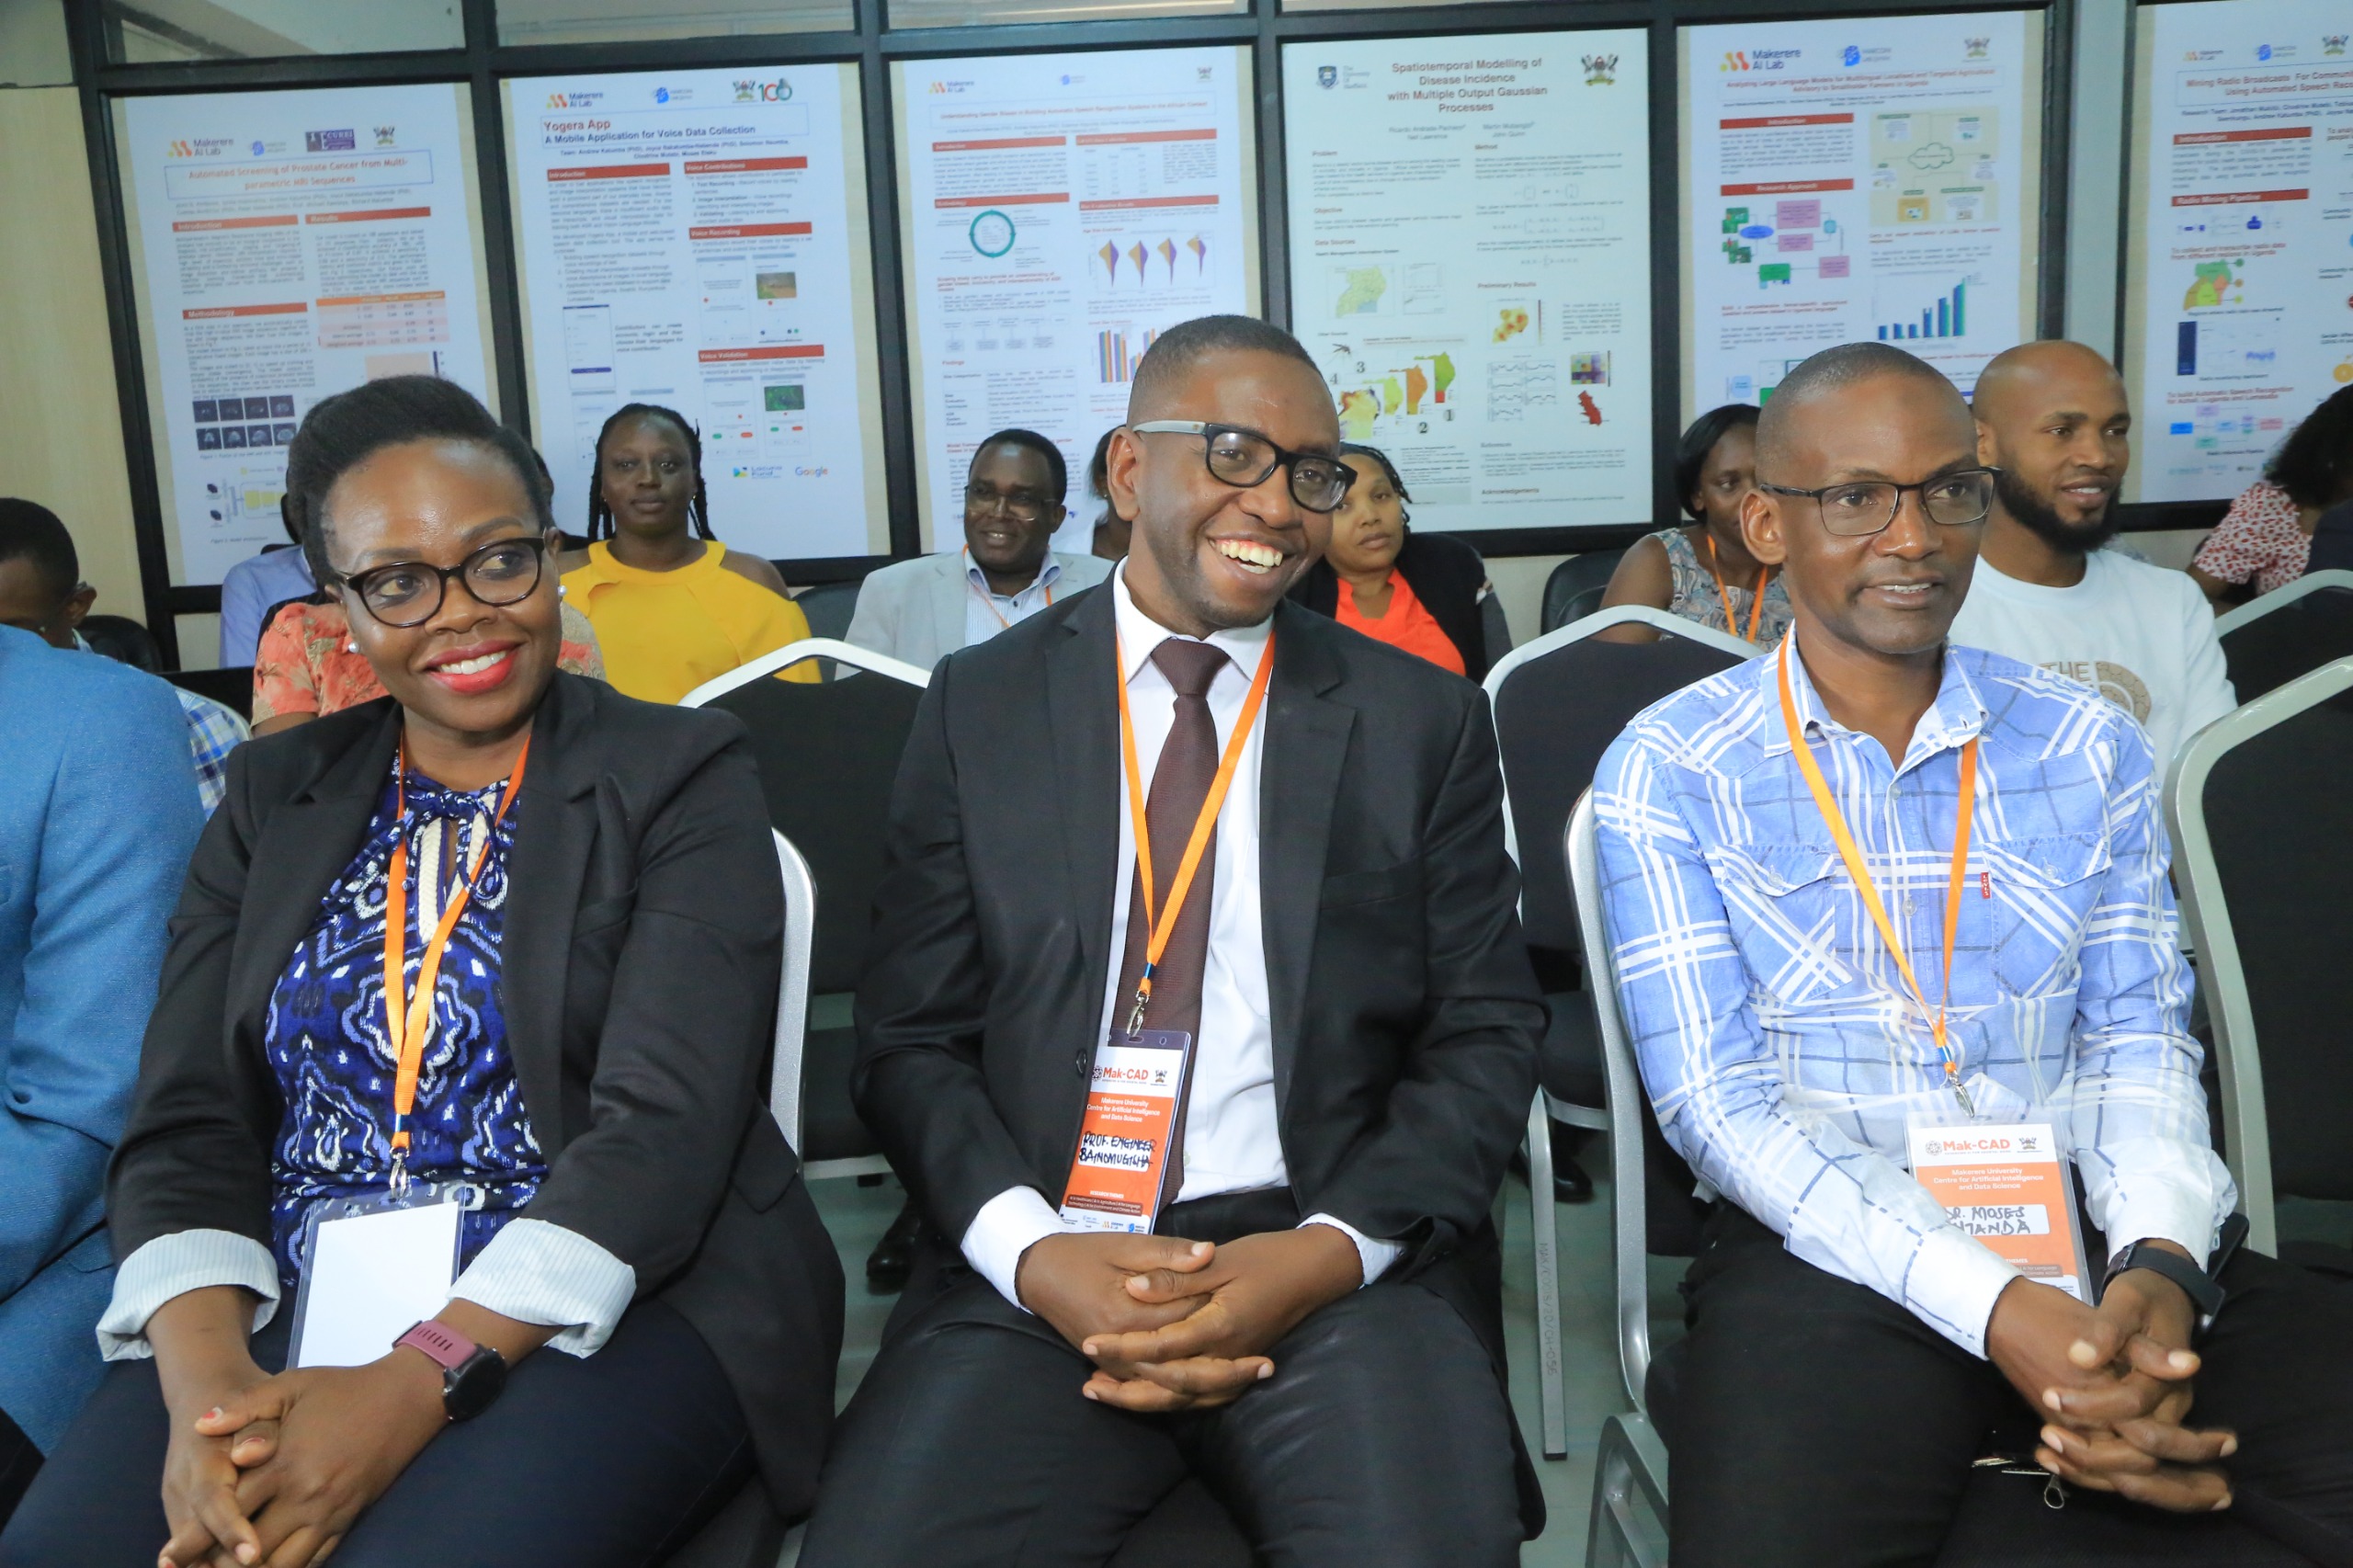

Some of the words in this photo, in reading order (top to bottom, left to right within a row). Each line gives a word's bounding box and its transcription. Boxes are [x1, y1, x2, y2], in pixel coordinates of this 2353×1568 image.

[1753, 50, 1802, 59] Makerere
[1392, 61, 1473, 74] Spatiotemporal
[1476, 59, 1528, 70] Modelling
[1531, 57, 1542, 67] of
[1753, 61, 1763, 70] AI
[1766, 61, 1785, 70] Lab
[1419, 75, 1461, 86] Disease
[1464, 74, 1516, 85] Incidence
[2243, 75, 2290, 84] Broadcasts
[1388, 91, 1410, 101] with
[1413, 90, 1455, 100] Multiple
[1458, 88, 1495, 99] Output
[1498, 86, 1548, 97] Gaussian
[2252, 85, 2296, 94] Automated
[2300, 84, 2329, 92] Speech
[1439, 103, 1495, 113] Processes
[544, 120, 585, 133] Yogera
[587, 119, 610, 131] App
[1768, 118, 1807, 126] Introduction
[553, 134, 585, 143] Mobile
[588, 131, 640, 143] Application
[656, 129, 683, 138] Voice
[686, 127, 706, 137] Data
[709, 125, 756, 136] Collection
[206, 148, 221, 156] Lab
[189, 169, 235, 179] Automated
[237, 166, 279, 178] Screening
[291, 164, 326, 173] Prostate
[329, 162, 358, 171] Cancer
[361, 160, 382, 168] from
[686, 164, 703, 172] Voice
[704, 162, 746, 171] Contributions
[311, 176, 355, 187] Sequences
[1756, 184, 1785, 193] Research
[1788, 182, 1818, 191] Approach
[178, 222, 222, 230] Introduction
[709, 227, 741, 237] Recording
[1478, 281, 1511, 290] Preliminary
[188, 308, 235, 318] Methodology
[1357, 361, 1366, 373] 3
[1329, 373, 1339, 385] 4
[1419, 421, 1428, 434] 2
[794, 466, 828, 478] Google
[1482, 487, 1540, 496] Acknowledgements
[1103, 1066, 1149, 1081] Mak-CAD
[1124, 1098, 1149, 1108] University
[1112, 1106, 1131, 1114] Artificial
[1131, 1108, 1161, 1117] Intelligence
[1123, 1115, 1143, 1123] Science
[1943, 1139, 2010, 1152] Mak-CAD
[1986, 1167, 2022, 1176] University
[1971, 1175, 2001, 1183] Artificial
[2002, 1174, 2044, 1183] Intelligence
[1993, 1182, 2021, 1190] Science
[1971, 1206, 2026, 1221] MOSES
